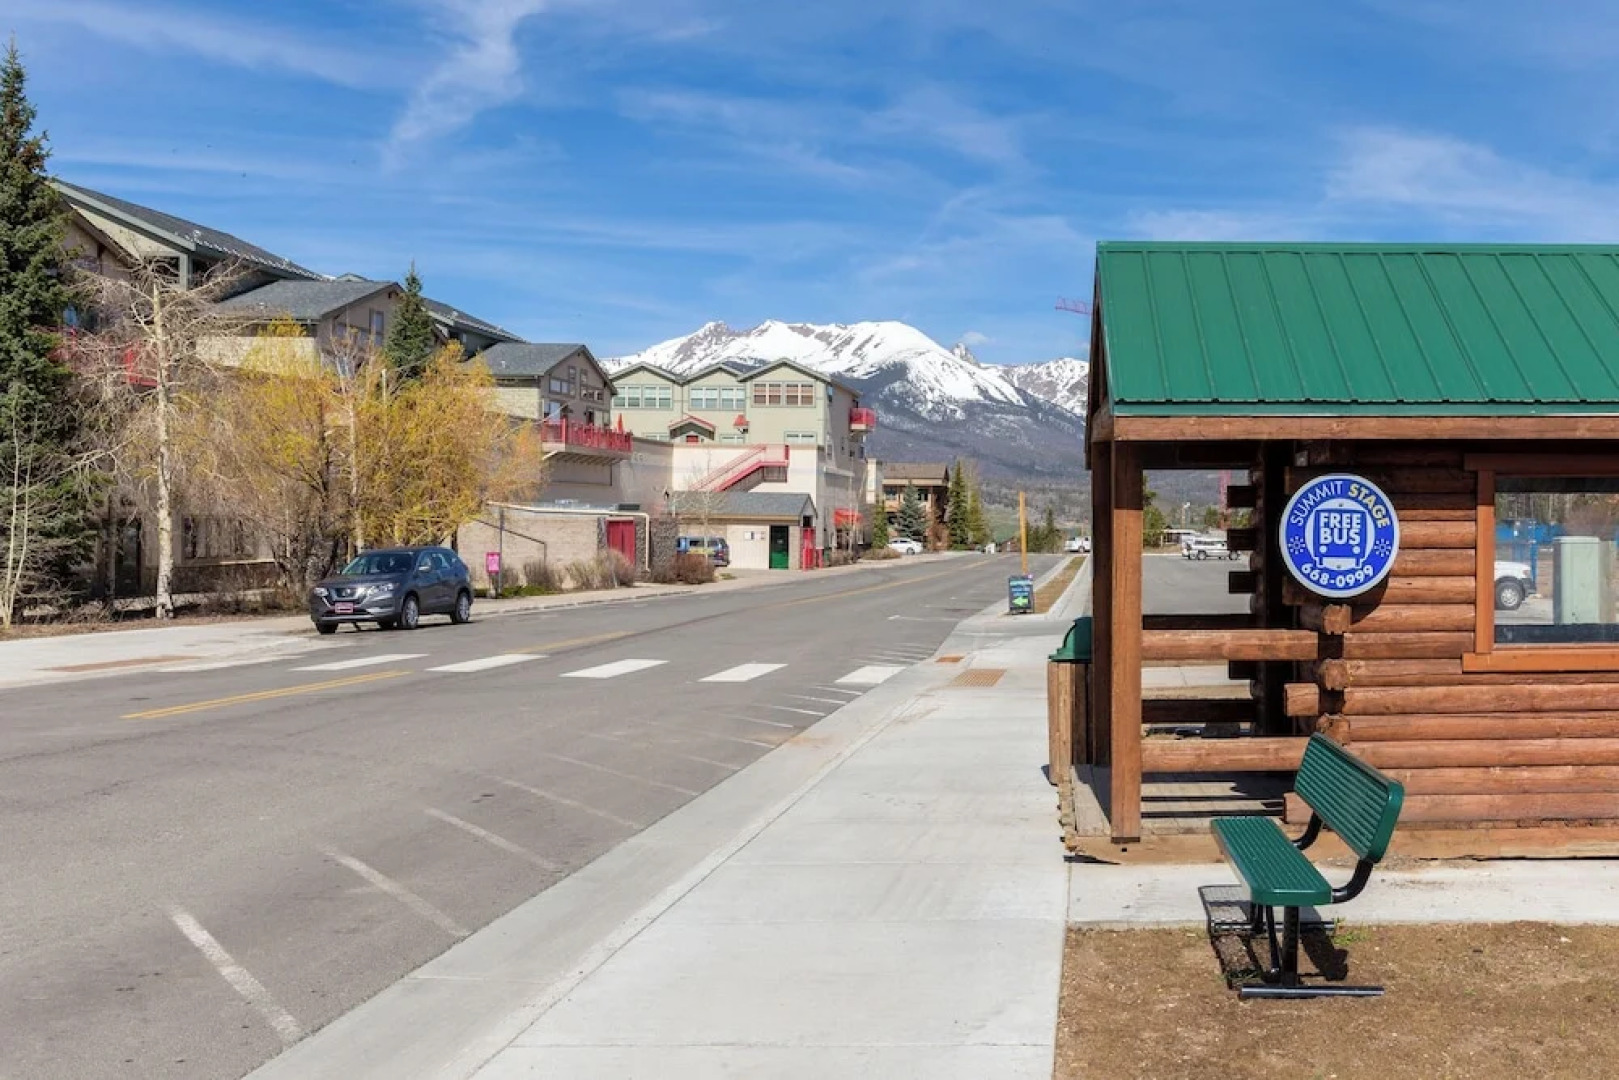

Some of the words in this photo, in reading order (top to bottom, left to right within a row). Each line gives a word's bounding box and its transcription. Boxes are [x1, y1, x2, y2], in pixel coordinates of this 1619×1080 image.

[1290, 480, 1343, 527] SUMMIT
[1348, 483, 1390, 528] STAGE
[1320, 512, 1361, 528] FREE
[1320, 528, 1361, 545] BUS
[1301, 563, 1374, 588] 668-0999
